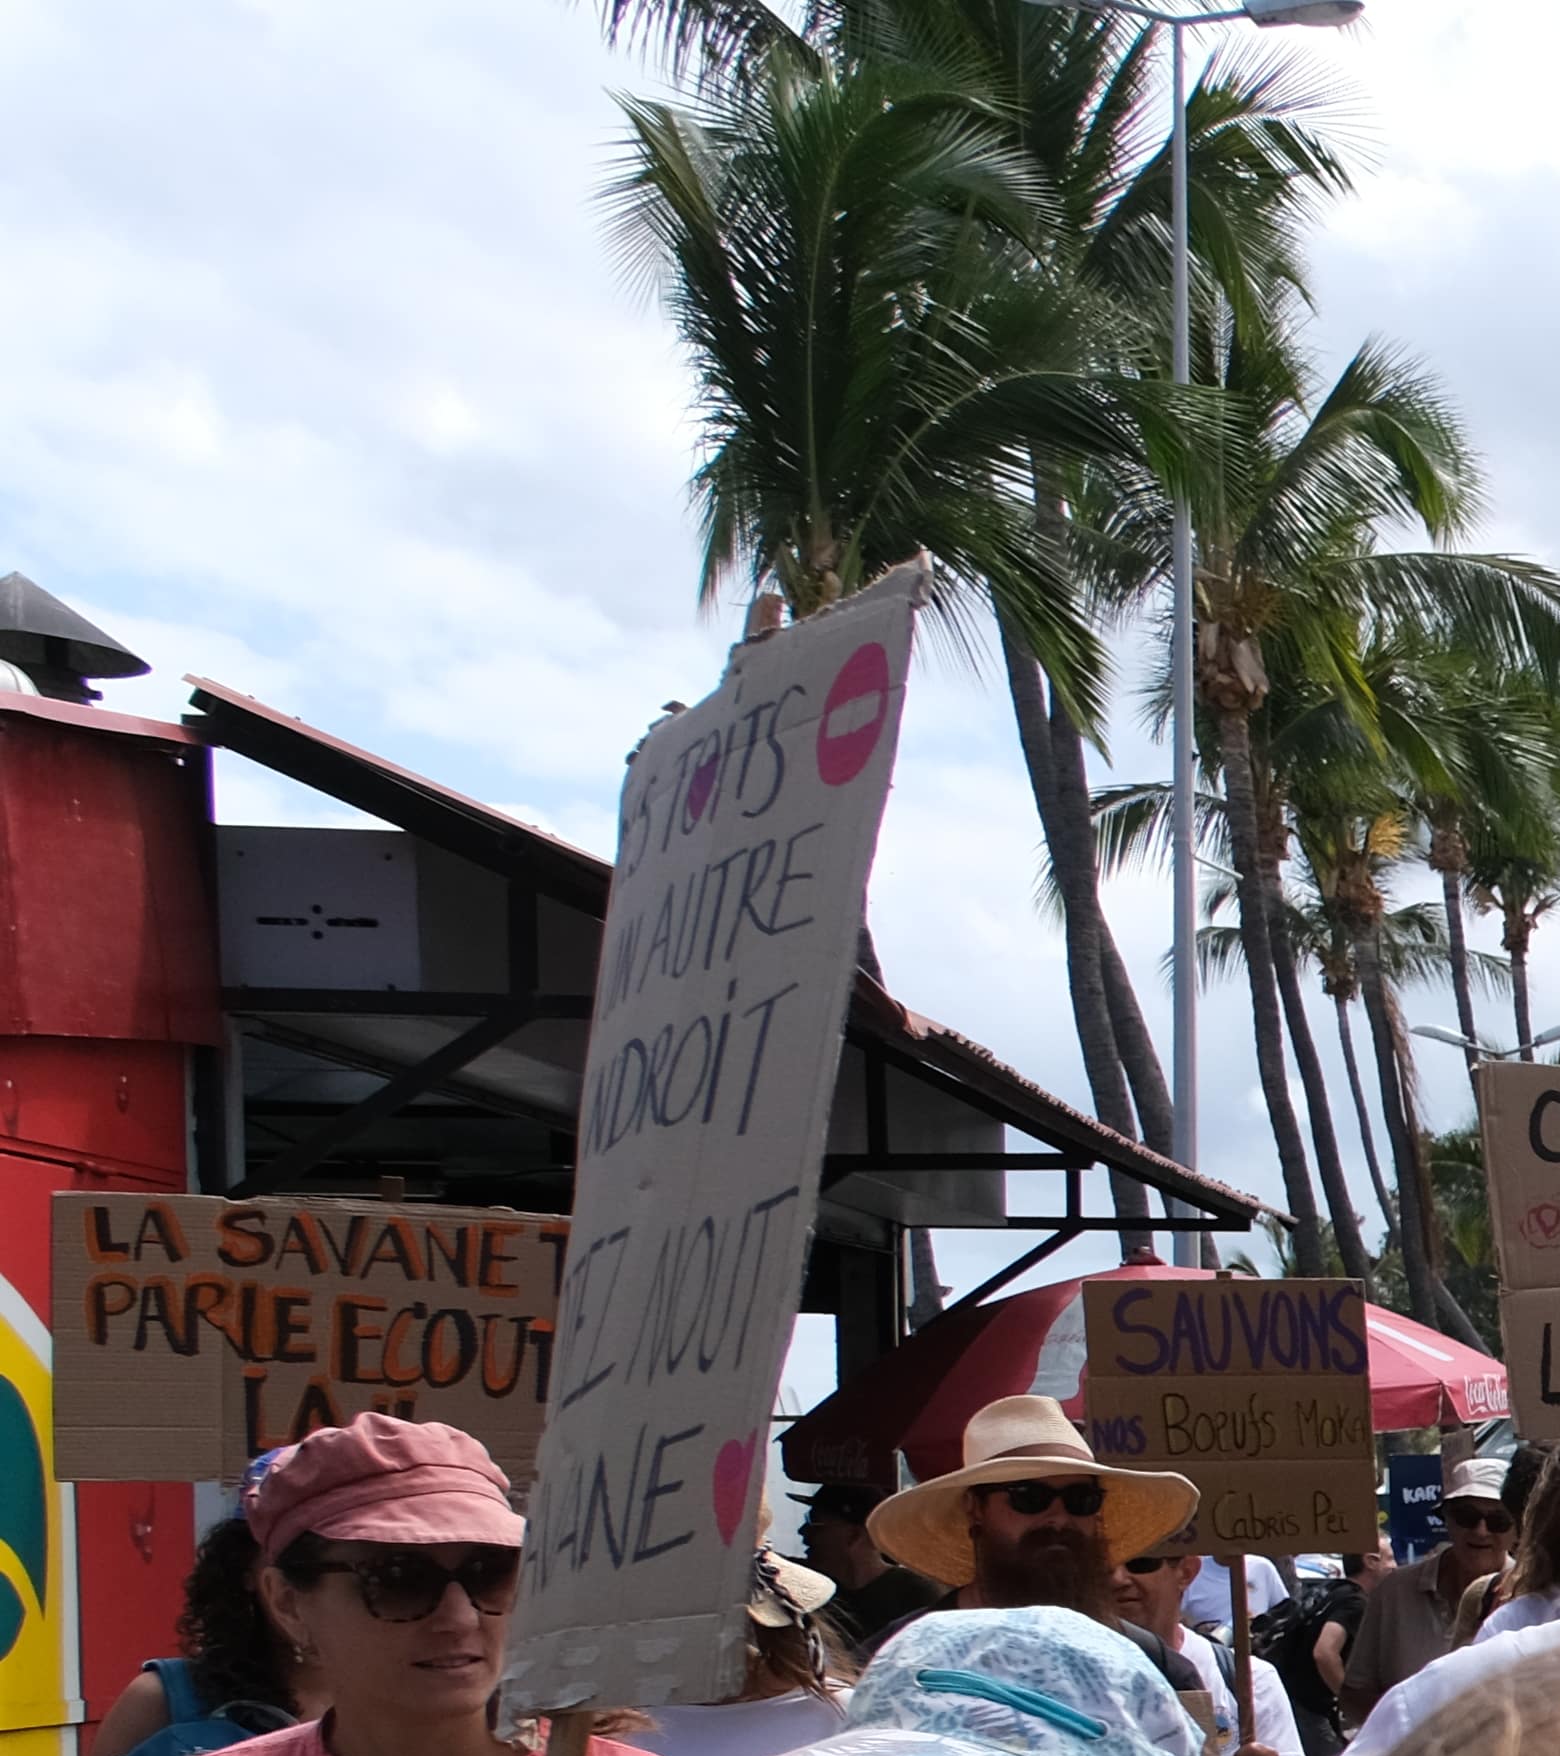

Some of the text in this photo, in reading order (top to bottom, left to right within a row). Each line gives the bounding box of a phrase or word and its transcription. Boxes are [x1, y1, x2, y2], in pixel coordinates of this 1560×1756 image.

[637, 822, 824, 994] AUTRE
[84, 1199, 191, 1264] LA
[215, 1204, 525, 1298] SAVANE
[625, 1184, 799, 1388] NOUT
[1112, 1286, 1370, 1376] SAUVONS
